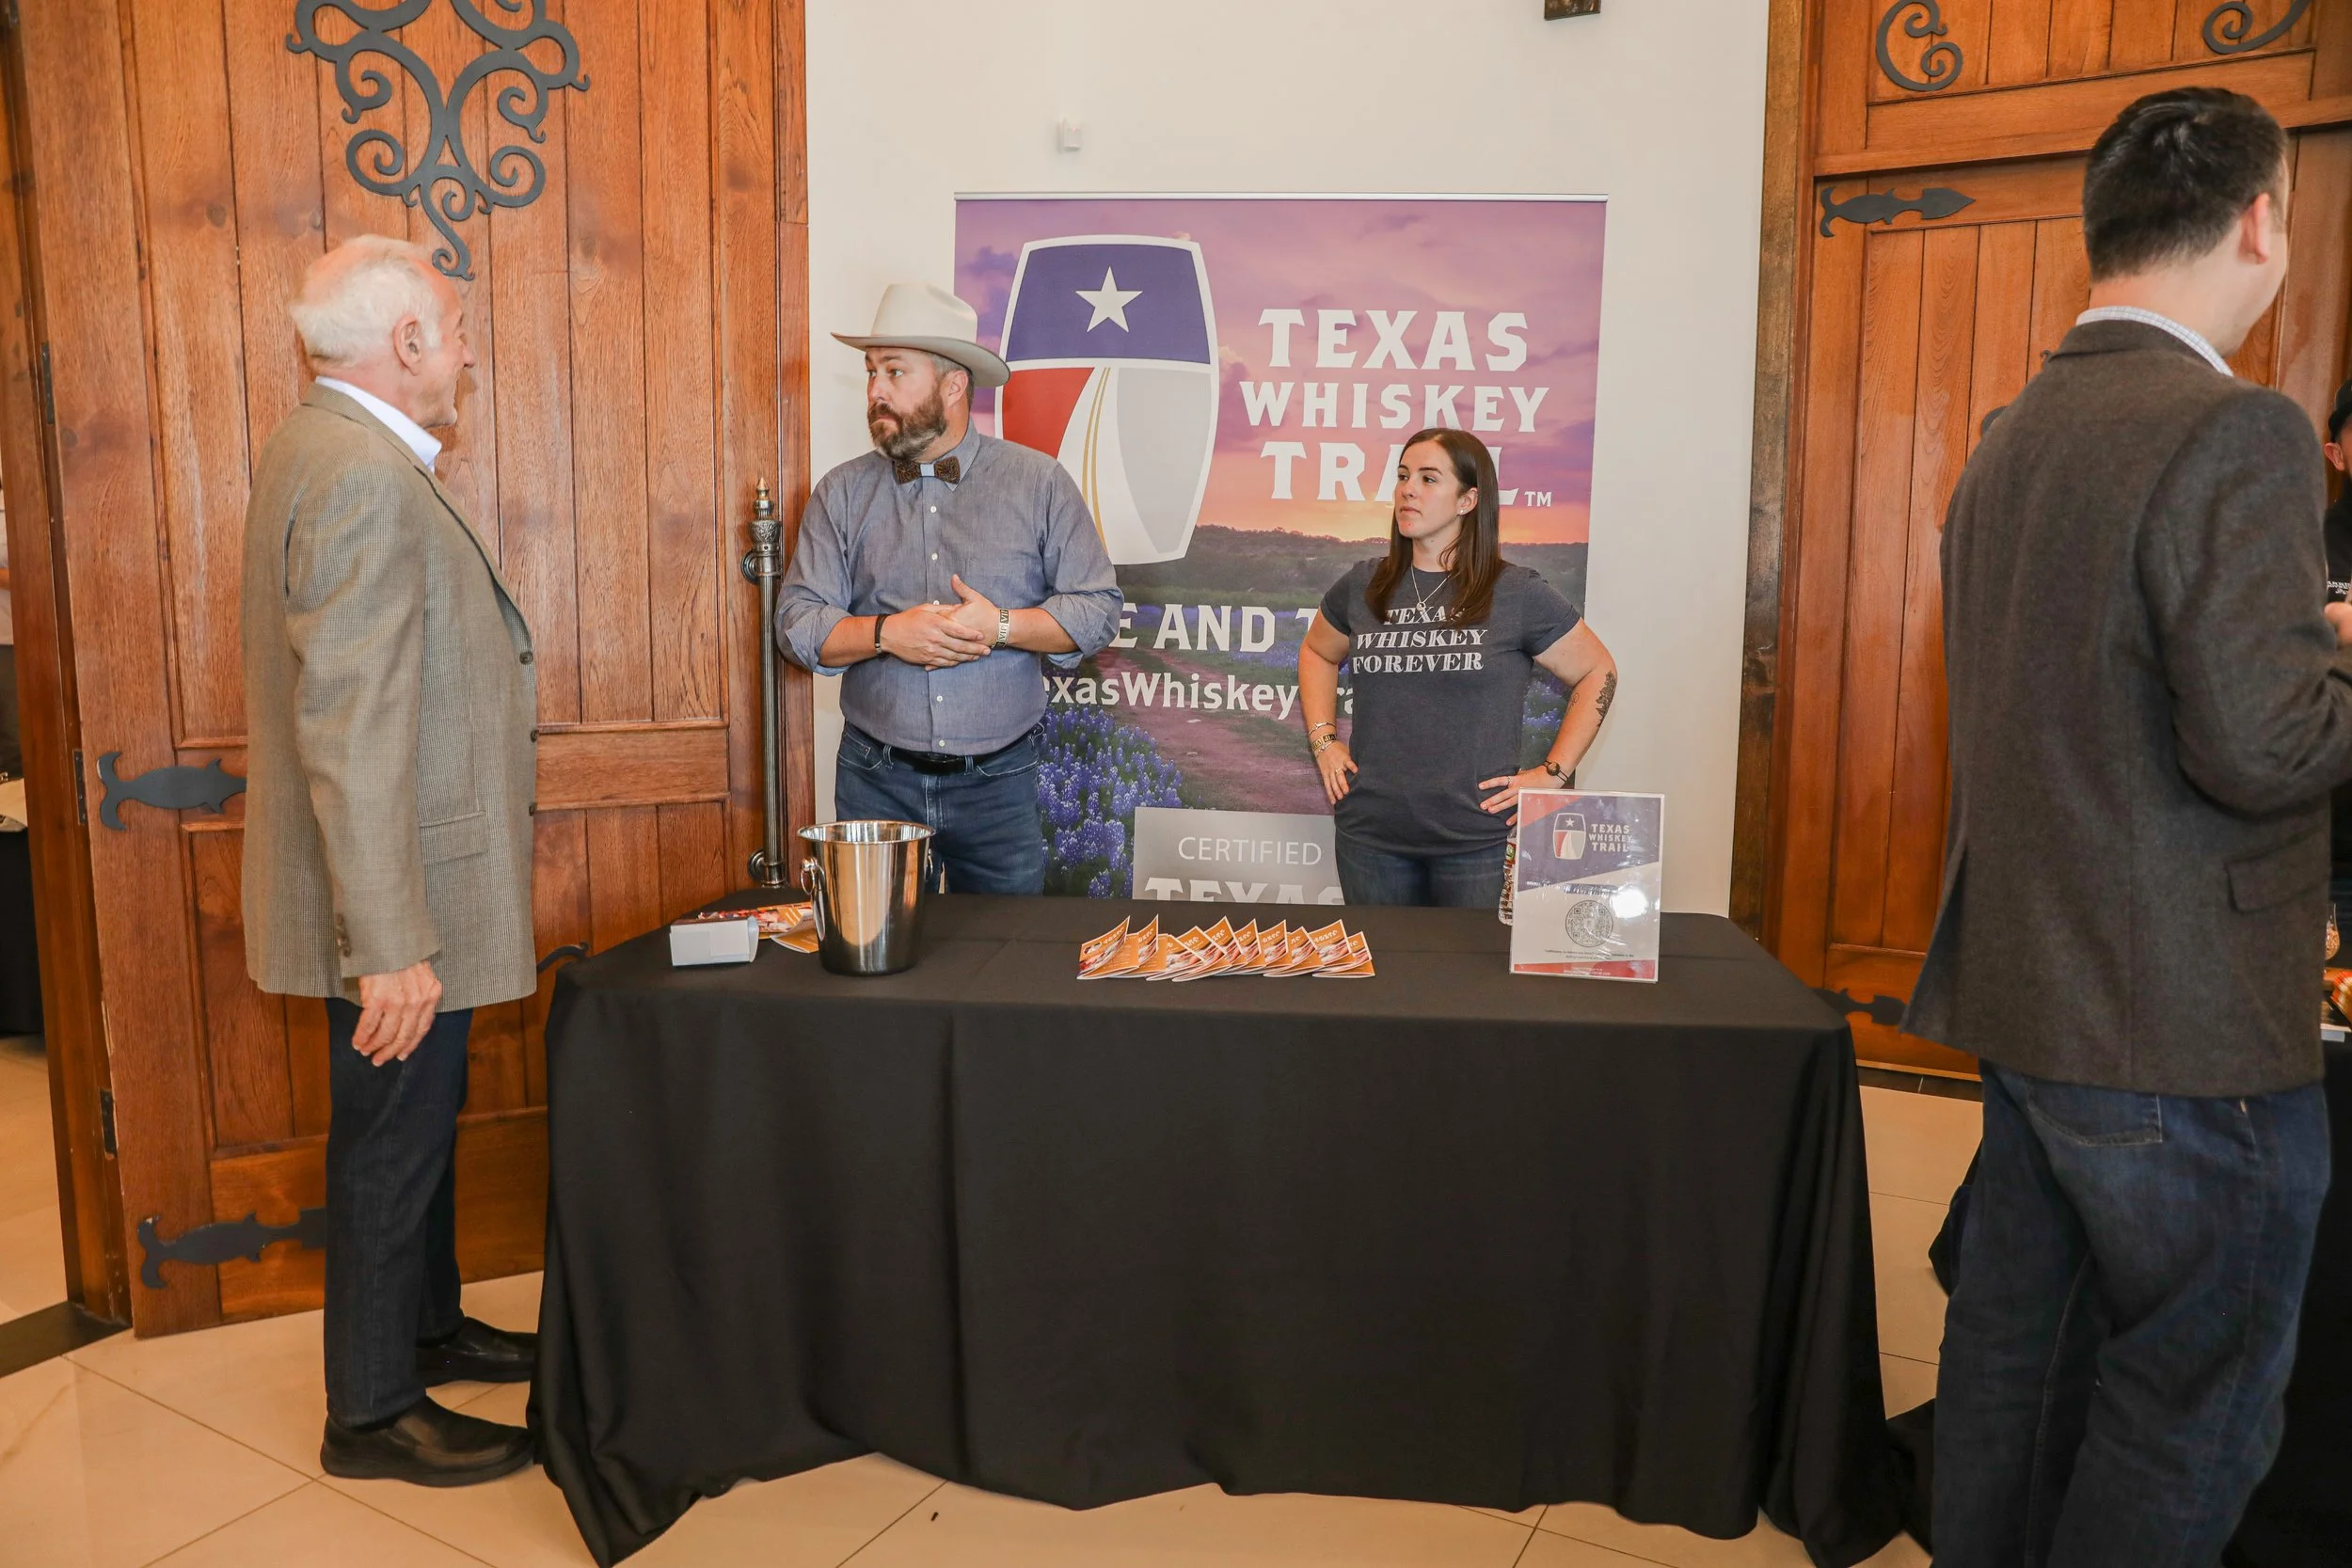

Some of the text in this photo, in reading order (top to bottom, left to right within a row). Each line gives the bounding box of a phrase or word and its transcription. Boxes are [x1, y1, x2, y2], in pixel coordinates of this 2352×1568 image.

[1258, 309, 1528, 372] TEXAS
[1239, 381, 1549, 432] WHISKEY
[1260, 441, 1552, 507] TRL TM
[1152, 603, 1275, 652] AND
[1357, 628, 1487, 650] WHISKEY
[1352, 652, 1485, 674] FOREVER
[1588, 833, 1633, 844] WHISKEY
[1591, 823, 1630, 834] TEXAS
[1178, 836, 1322, 865] CERTIFIED
[1591, 842, 1629, 852] TRAIL
